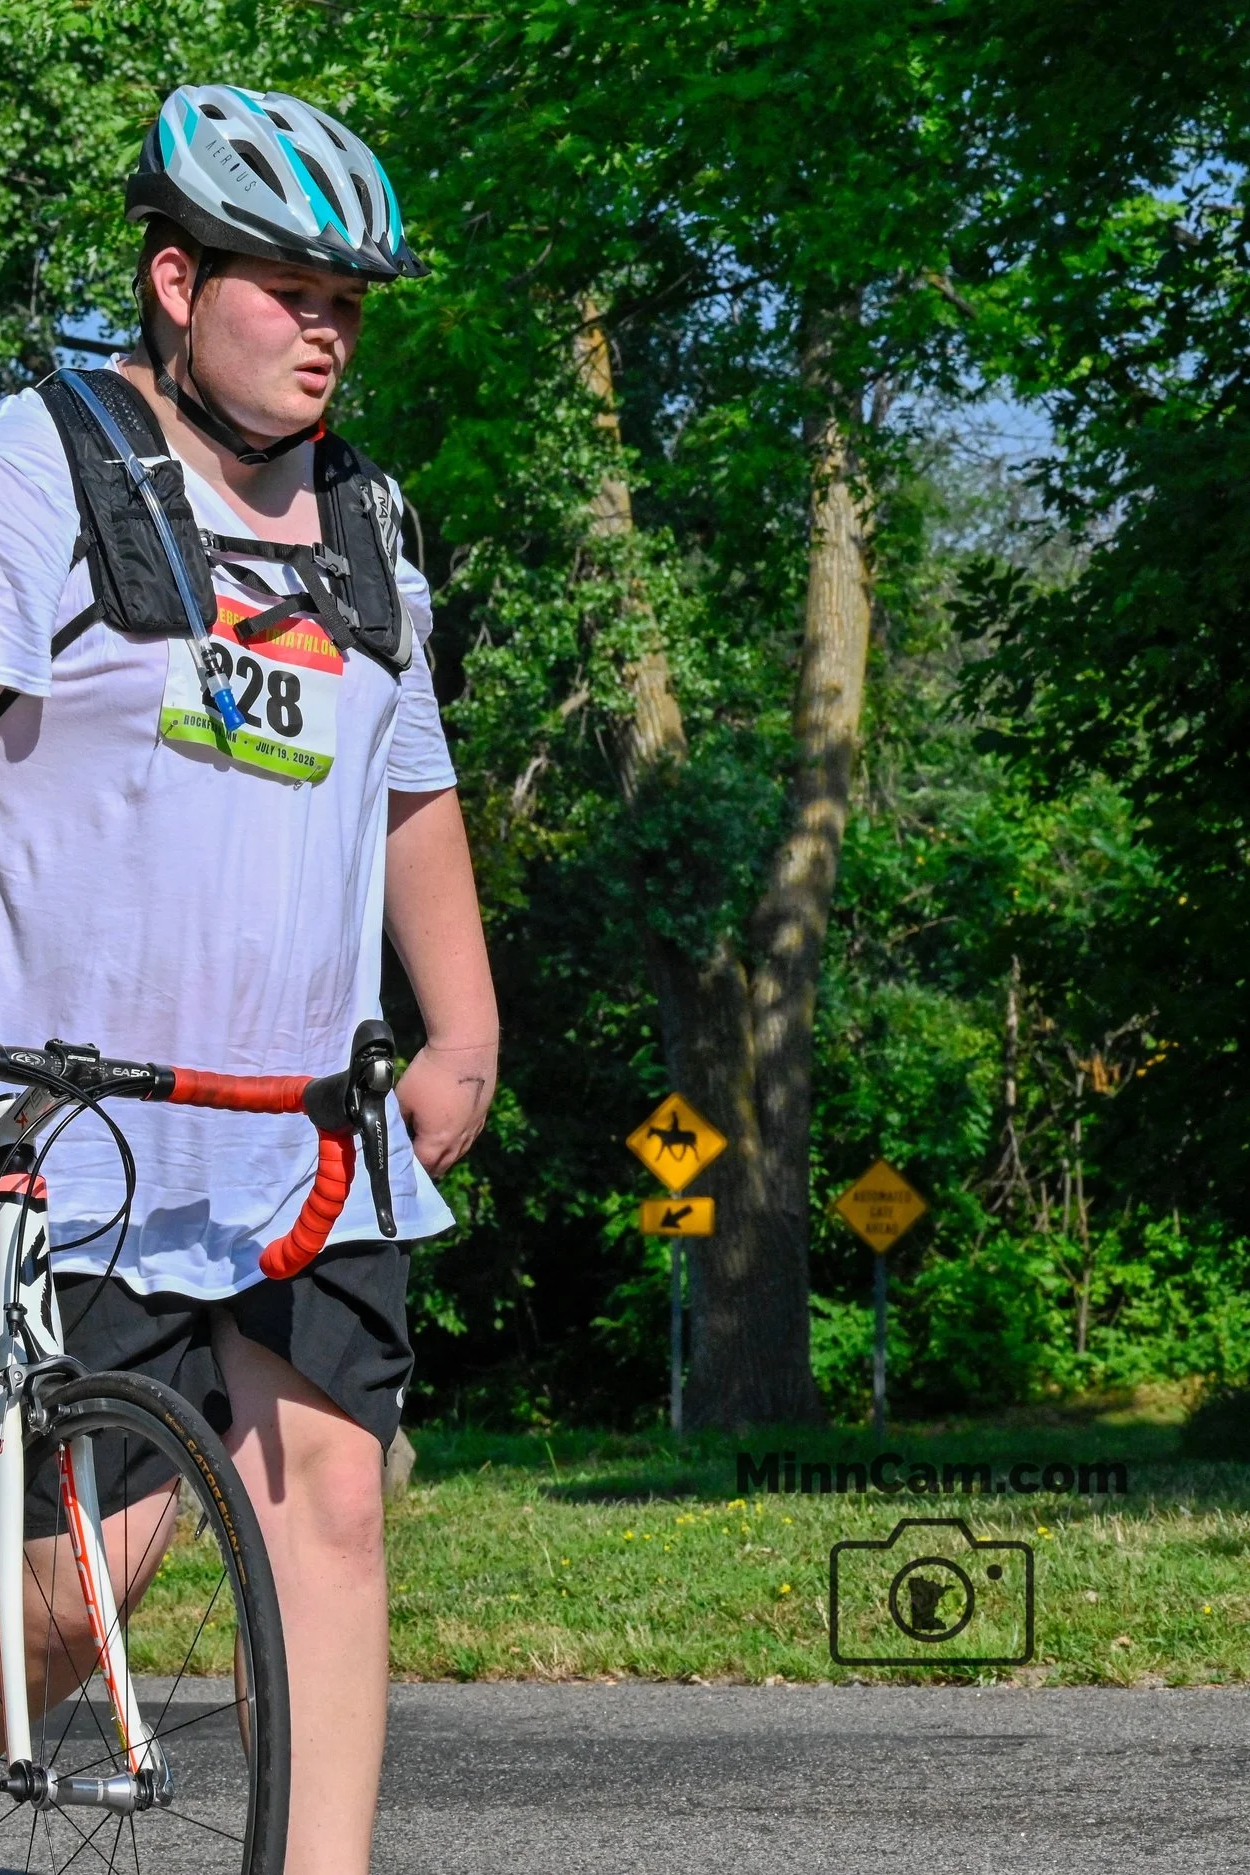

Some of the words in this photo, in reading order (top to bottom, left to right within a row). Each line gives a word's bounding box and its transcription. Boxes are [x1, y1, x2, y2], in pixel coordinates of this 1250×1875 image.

[266, 627, 340, 657] TRIATHLON
[255, 741, 275, 756] JULY
[277, 748, 290, 761] 19,
[293, 752, 315, 767] 2026
[112, 1067, 151, 1077] EA50
[374, 1120, 385, 1171] ULTEGRA
